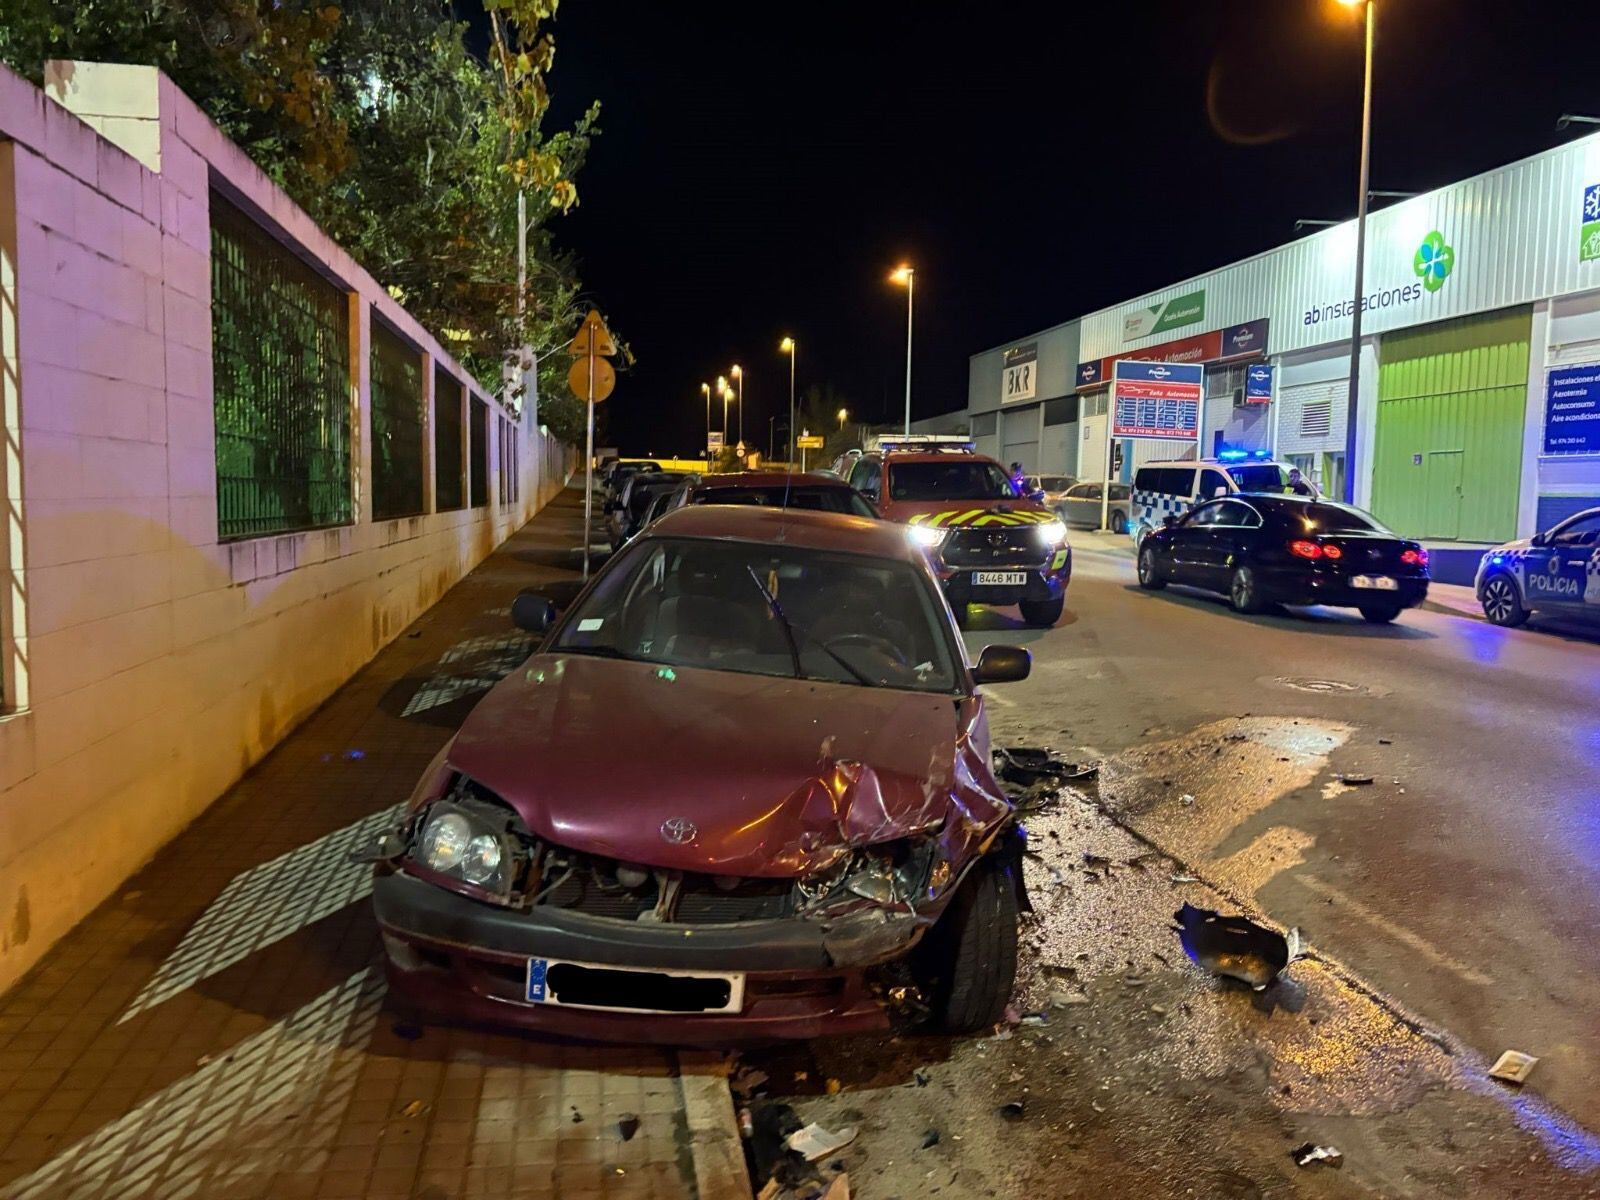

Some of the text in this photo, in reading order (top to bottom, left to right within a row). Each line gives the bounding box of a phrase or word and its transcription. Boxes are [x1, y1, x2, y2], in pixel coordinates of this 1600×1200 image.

[1008, 365, 1030, 394] BKR
[1553, 377, 1594, 386] Instalaciones
[1552, 389, 1587, 398] Aerotermia
[1552, 401, 1595, 410] Autoconsumo
[1551, 414, 1564, 422] Aire
[1529, 574, 1578, 595] POLICIA
[533, 984, 541, 994] E
